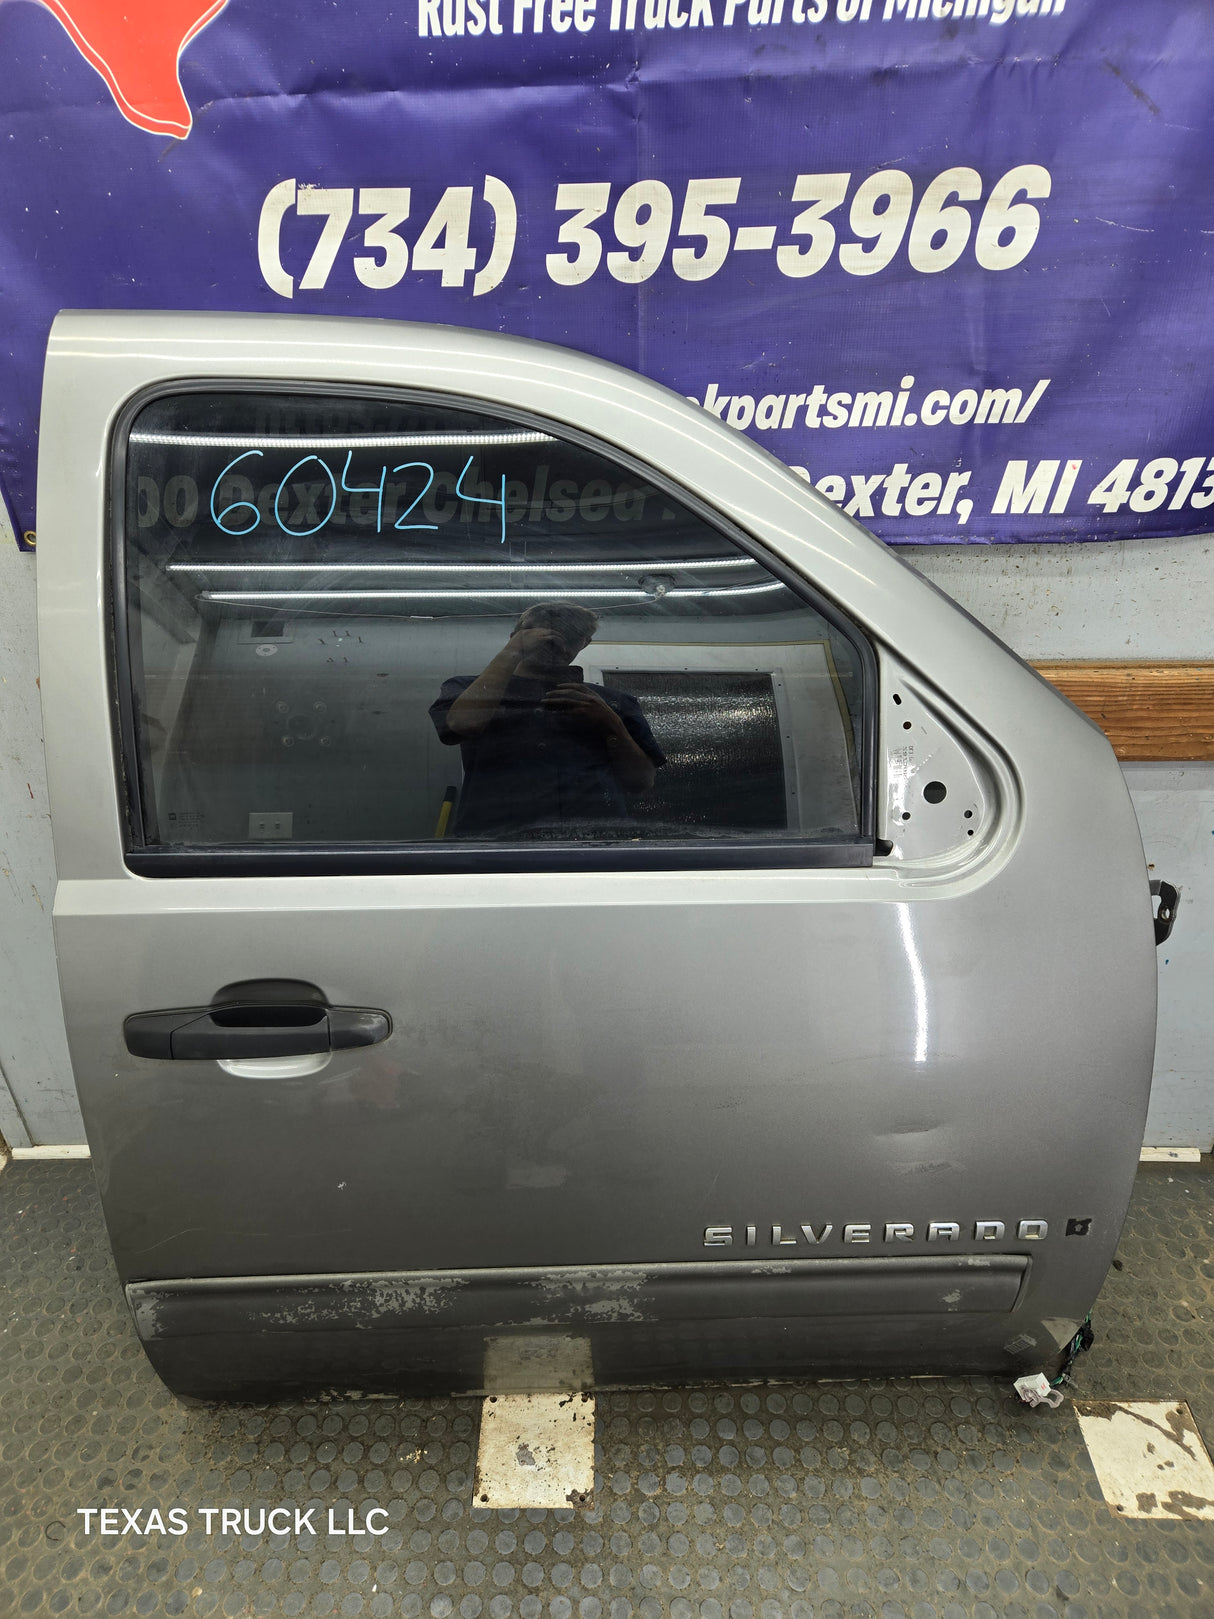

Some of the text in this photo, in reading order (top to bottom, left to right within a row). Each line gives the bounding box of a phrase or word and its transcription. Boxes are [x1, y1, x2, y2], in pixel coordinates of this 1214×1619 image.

[257, 164, 1053, 299] (734) 395-3966
[684, 374, 1052, 431] kpartsmi.com/
[209, 449, 507, 544] 60424
[217, 472, 407, 527] Dexter
[423, 464, 650, 524] Chelsea
[788, 465, 974, 525] exter,
[990, 459, 1084, 515] MI
[703, 1218, 1049, 1247] SILVERADO
